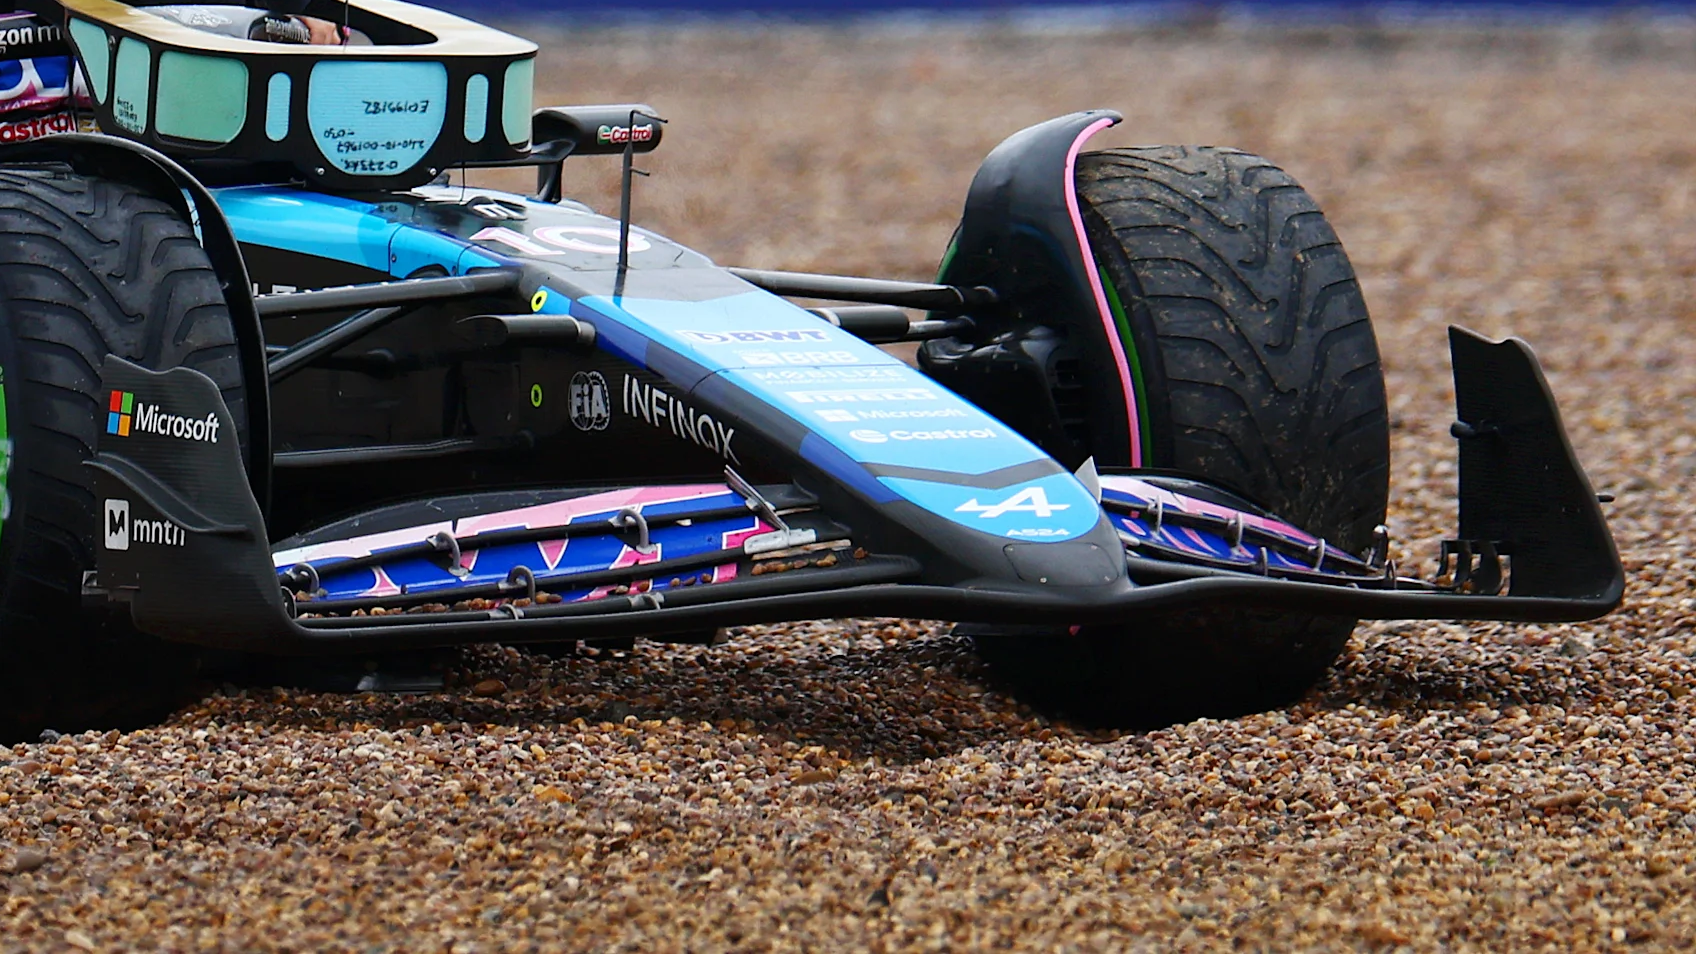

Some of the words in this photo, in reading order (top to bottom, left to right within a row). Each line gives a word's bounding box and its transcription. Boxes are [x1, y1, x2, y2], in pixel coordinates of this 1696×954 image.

[469, 226, 652, 255] 10
[730, 330, 830, 343] BWT
[781, 350, 860, 365] BRB
[786, 388, 939, 404] PIRELLI
[858, 408, 969, 421] Microsoft
[135, 402, 220, 444] Microsoft
[888, 427, 997, 442] Castrol
[1006, 528, 1071, 537] A524
